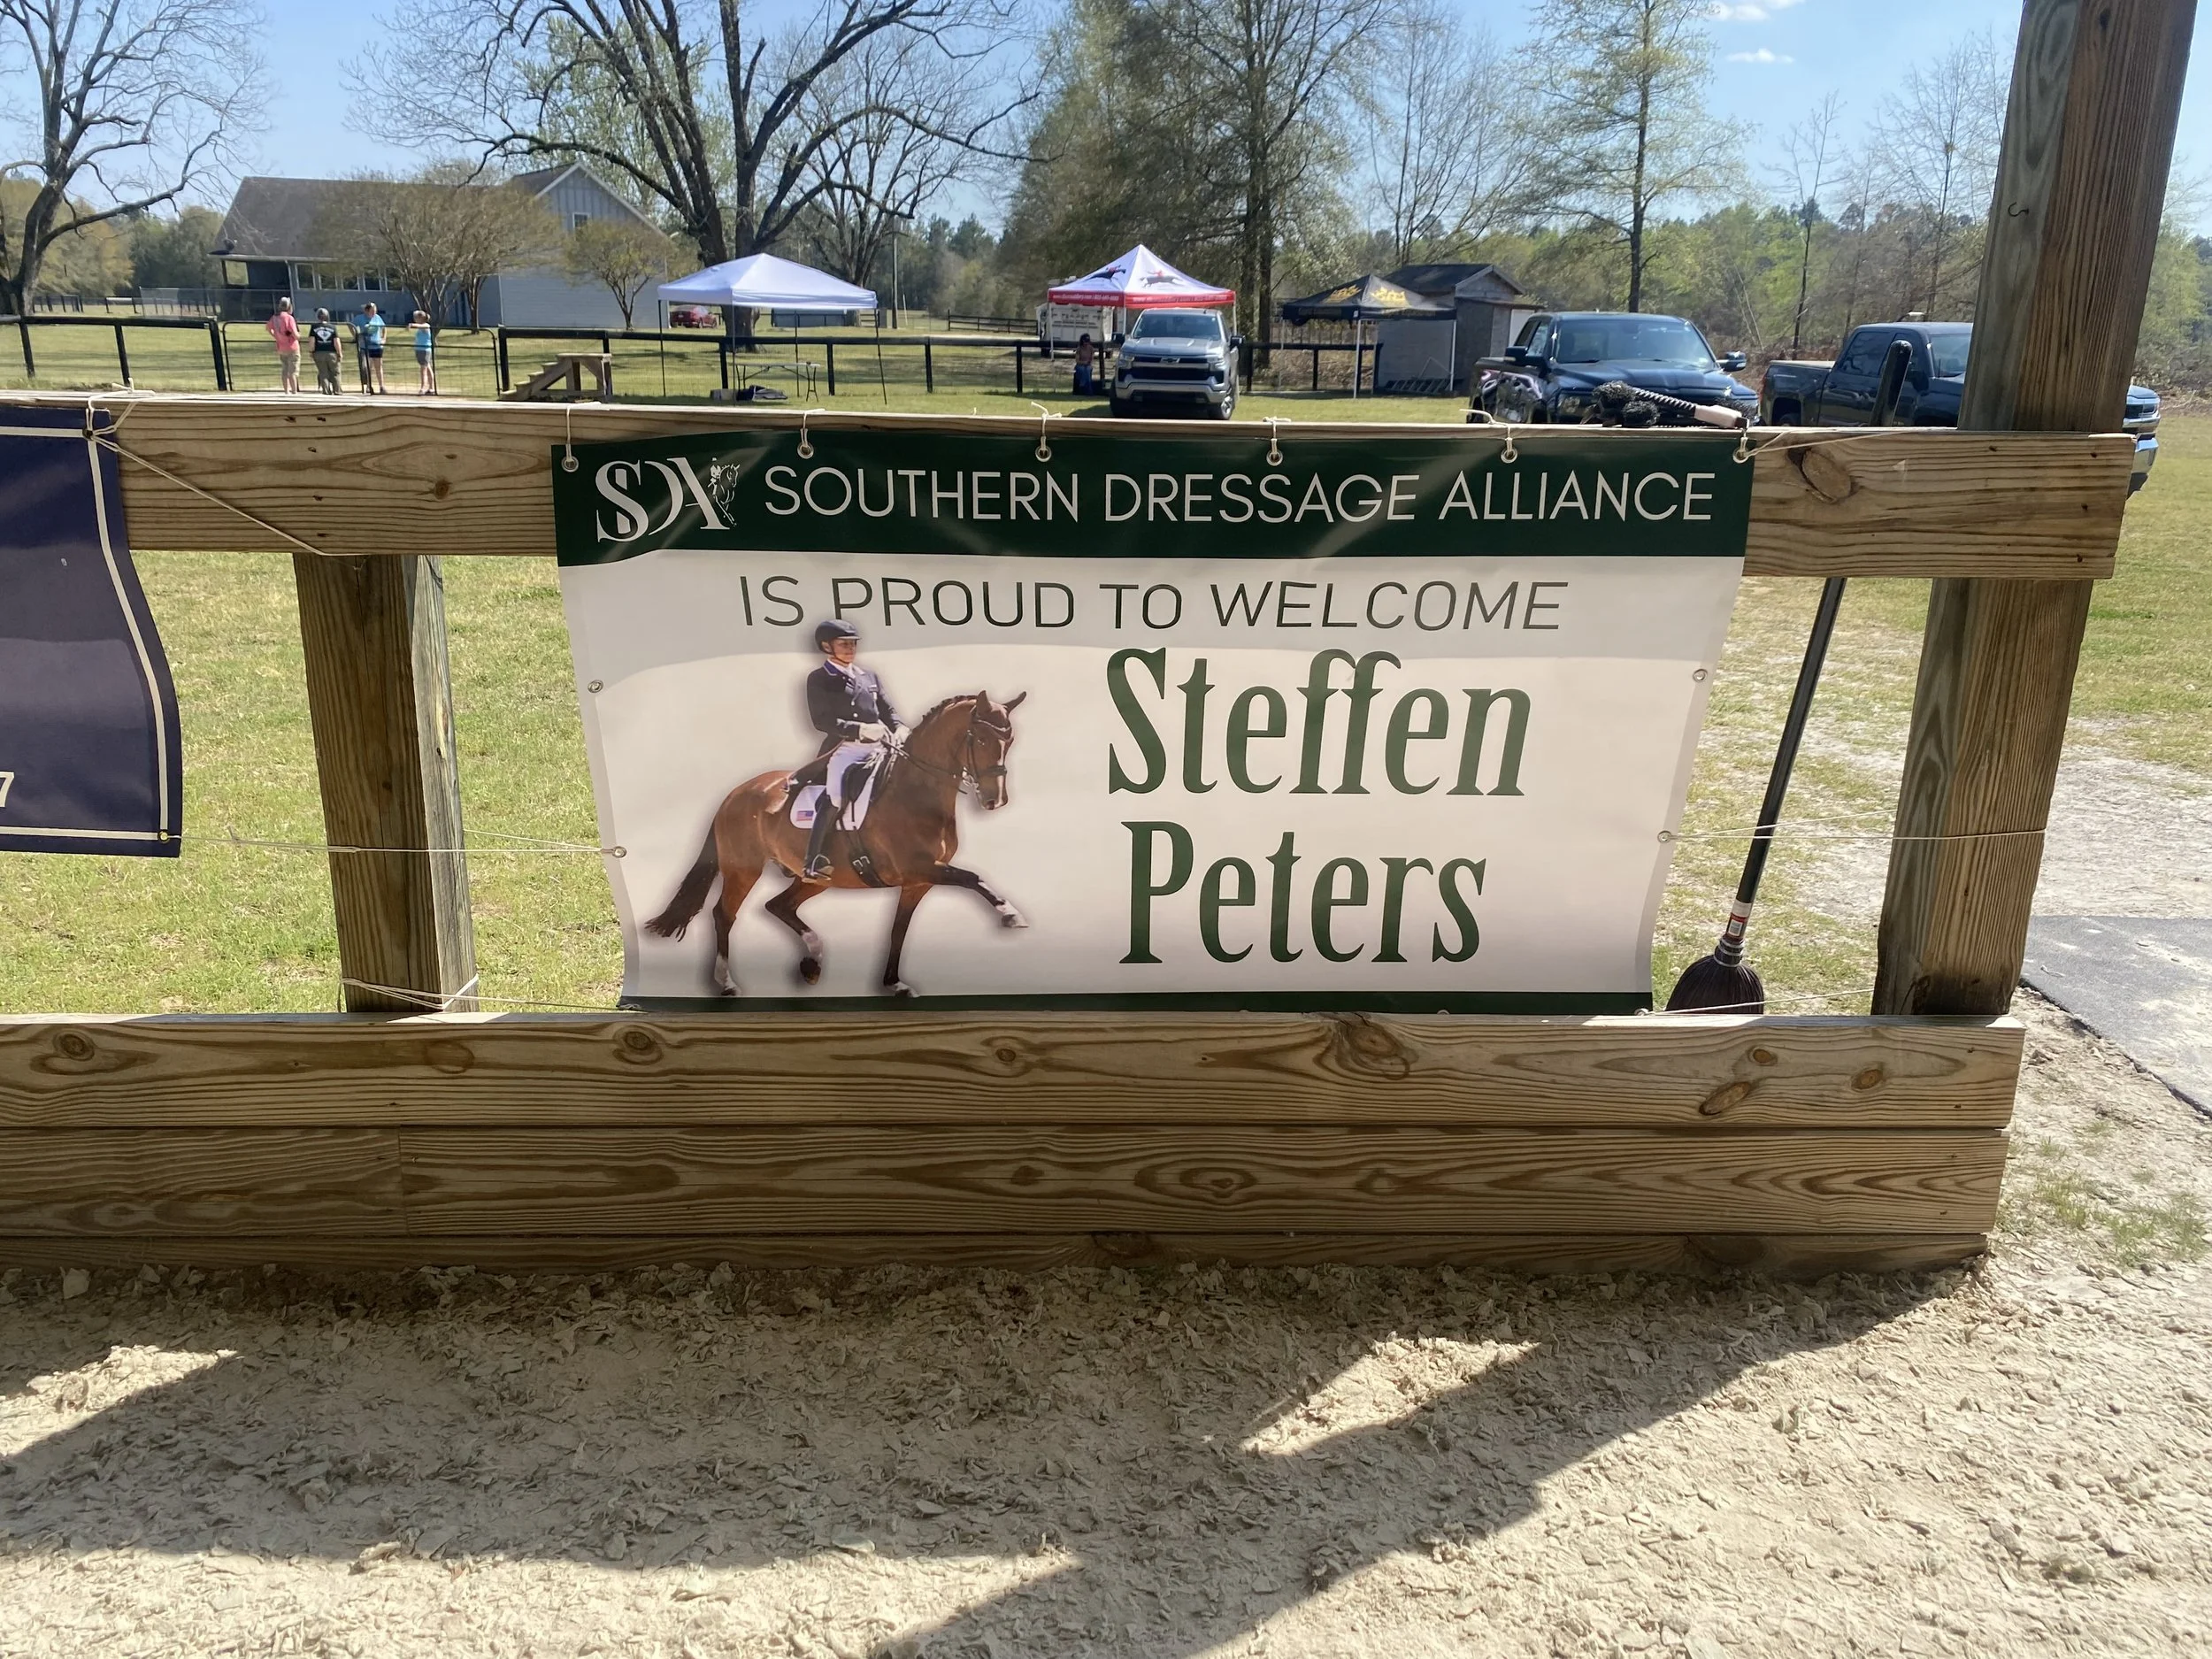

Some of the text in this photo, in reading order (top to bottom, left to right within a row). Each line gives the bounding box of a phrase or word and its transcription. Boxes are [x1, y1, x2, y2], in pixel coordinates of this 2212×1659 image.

[764, 465, 1716, 523] SOUTHERN DRESSAGE ALLIANCE
[739, 575, 1570, 632] IS PROUD TO WELCOME
[1106, 647, 1532, 796] Steffen
[1118, 820, 1487, 964] Peters
